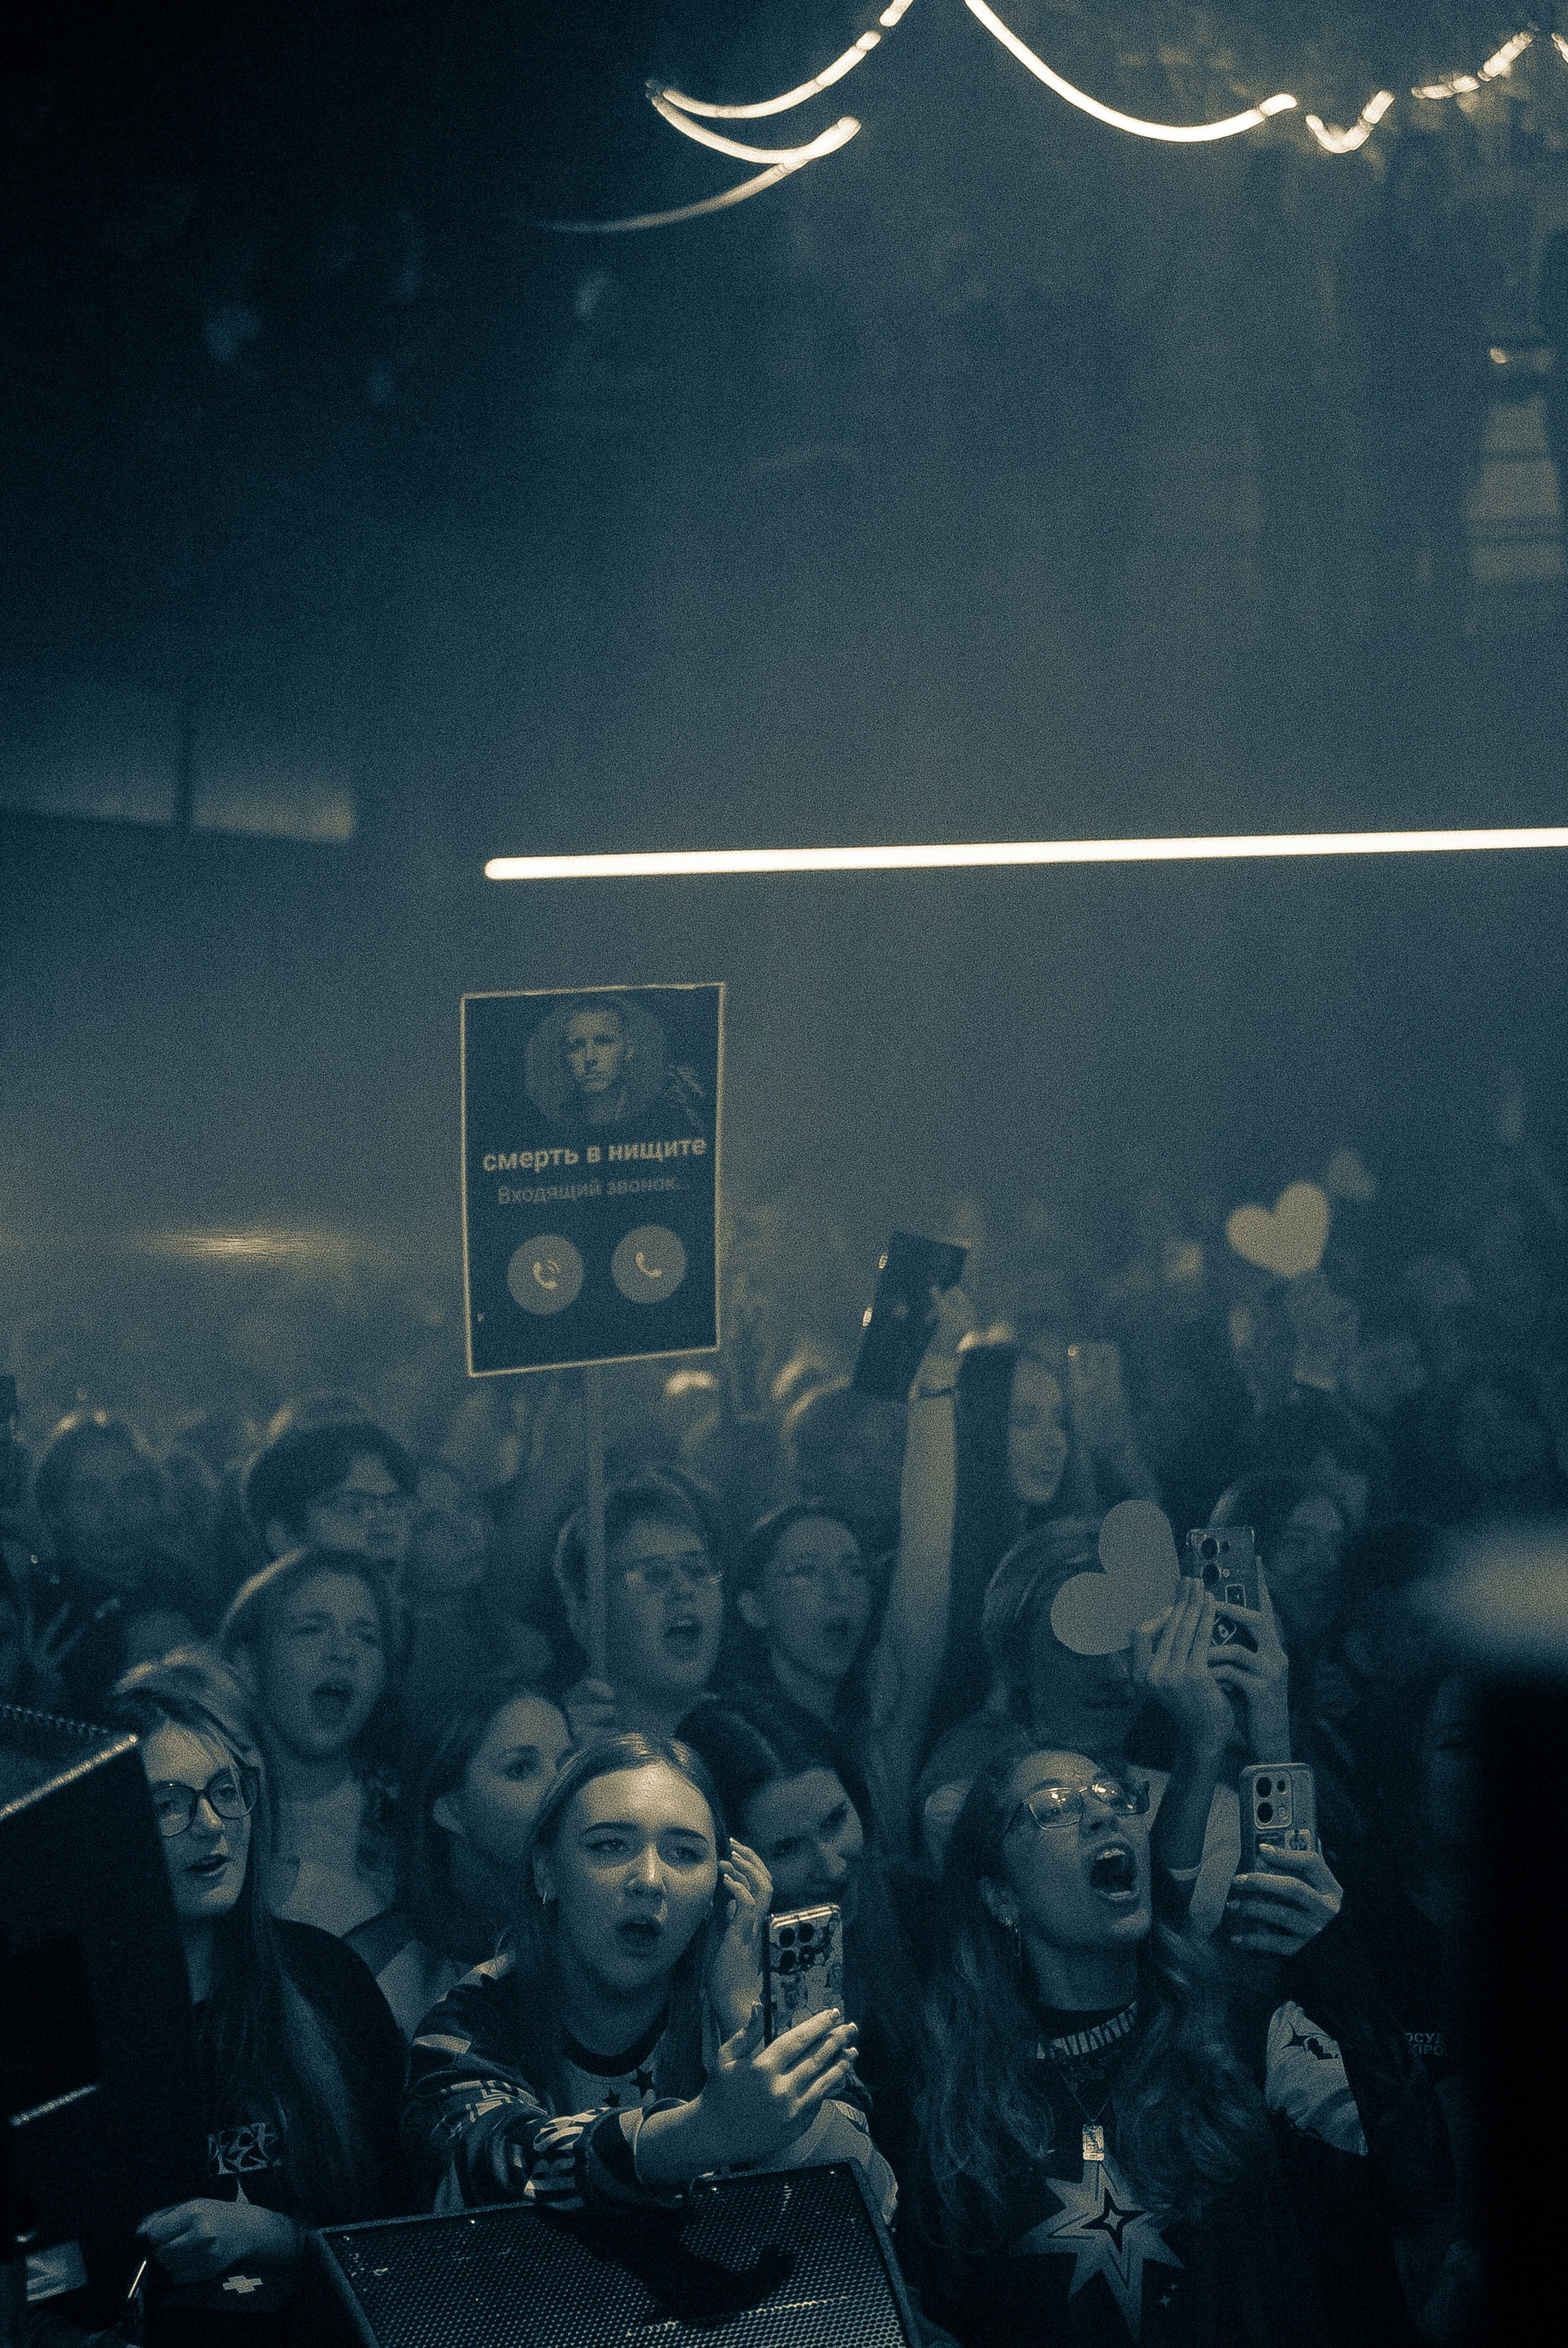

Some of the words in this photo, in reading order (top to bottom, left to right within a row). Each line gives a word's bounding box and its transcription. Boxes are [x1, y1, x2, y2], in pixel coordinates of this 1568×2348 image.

[483, 1148, 579, 1173] смерть
[586, 1146, 601, 1163] в
[608, 1138, 707, 1163] нищите
[498, 1178, 601, 1204] Входящий
